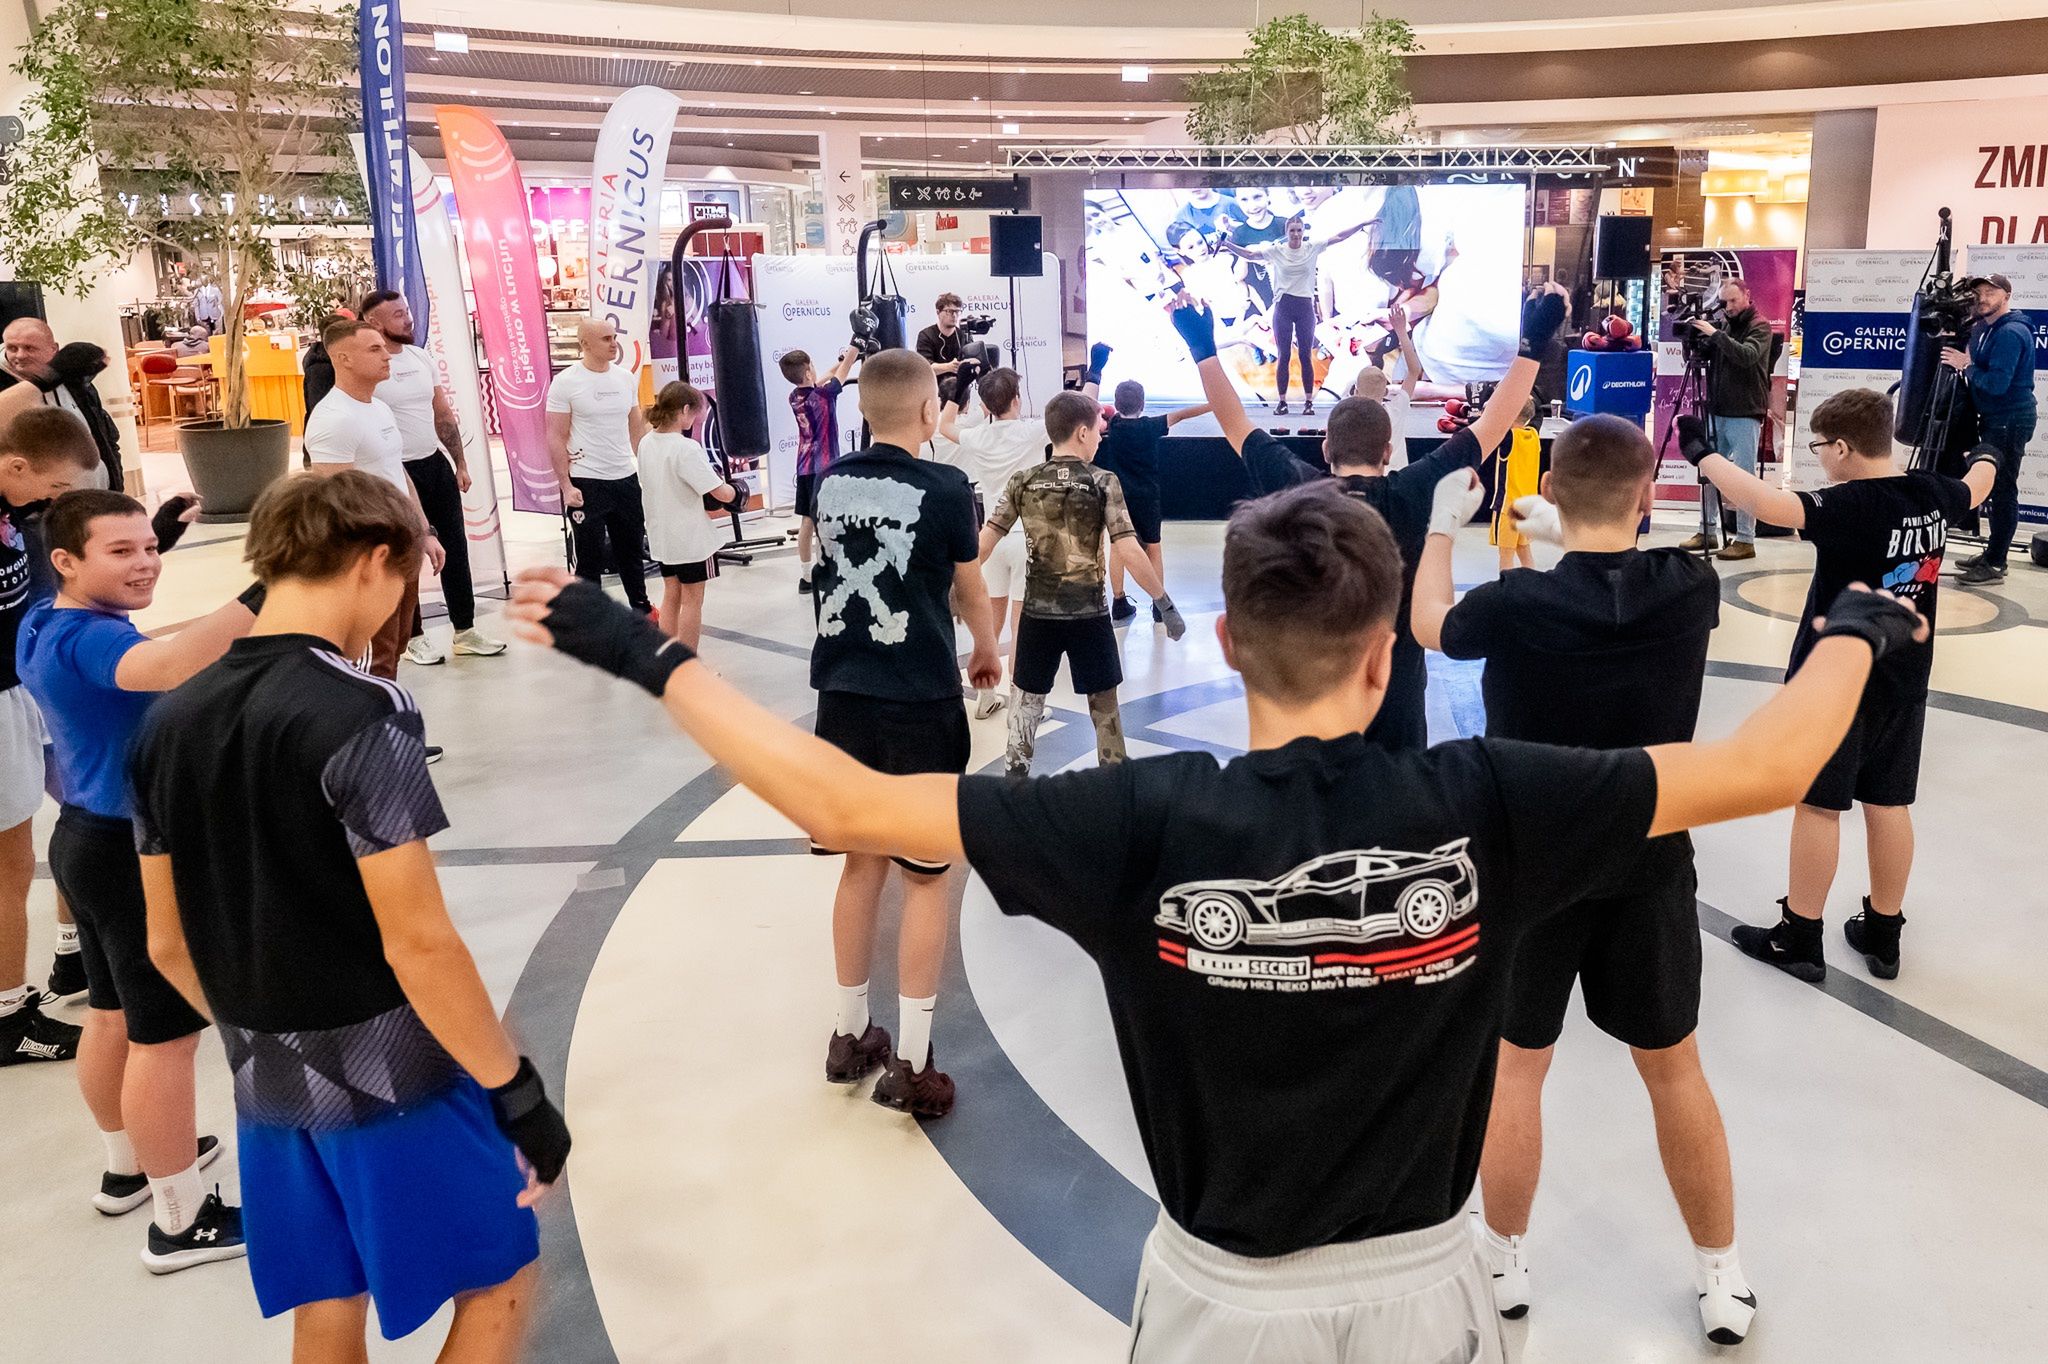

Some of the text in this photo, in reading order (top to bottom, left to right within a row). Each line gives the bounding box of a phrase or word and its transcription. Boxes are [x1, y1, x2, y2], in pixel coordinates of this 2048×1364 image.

[118, 191, 350, 218] VISTULA
[596, 174, 619, 302] GALERIA
[905, 263, 950, 274] COPERNICUS
[782, 303, 831, 321] COPERNICUS
[962, 302, 1012, 312] PERNICU
[1855, 327, 1907, 336] GALERIA
[1003, 338, 1047, 351] COERNICUS
[1823, 331, 1906, 355] COPERNIC
[1033, 481, 1090, 492] POLSKA
[1250, 961, 1306, 976] SECRET
[1312, 966, 1371, 978] SUPER GT-R
[1207, 976, 1248, 990] GReddy
[1250, 980, 1274, 990] HKS
[1276, 981, 1309, 992] NEKO
[1346, 976, 1380, 988] BRIDE
[1383, 967, 1422, 981] TAKATA
[16, 1036, 60, 1058] LONSDALE
